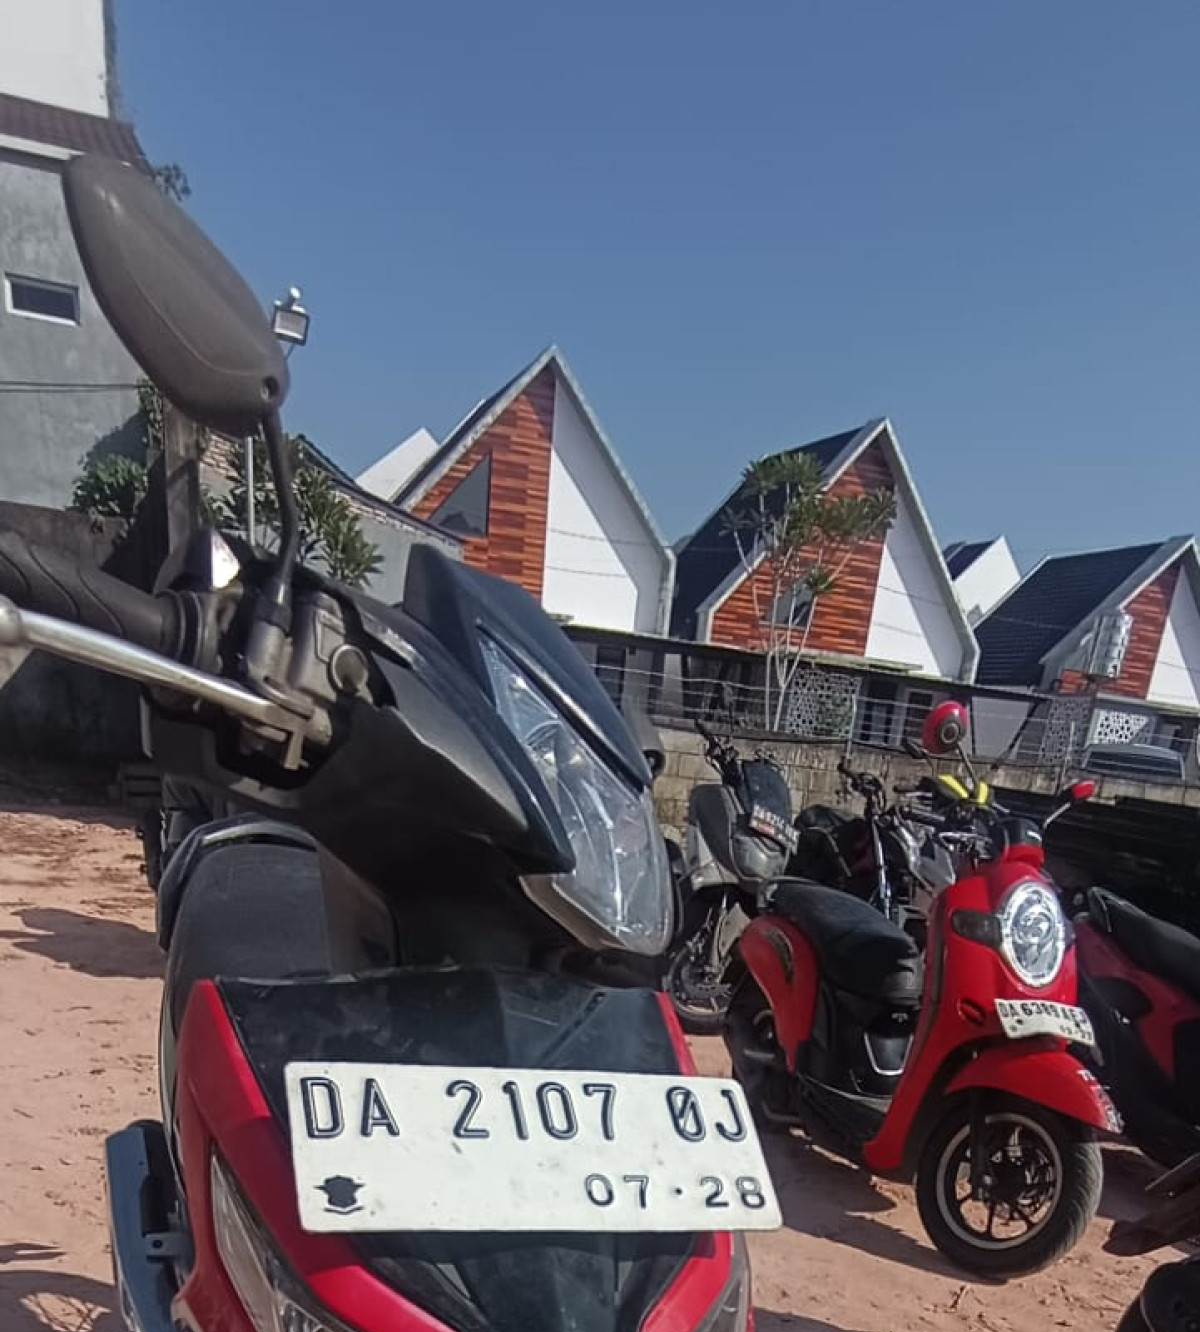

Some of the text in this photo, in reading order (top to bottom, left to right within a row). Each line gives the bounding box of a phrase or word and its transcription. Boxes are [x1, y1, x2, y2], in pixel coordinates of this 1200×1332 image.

[998, 1003, 1019, 1018] DA
[300, 1077, 400, 1138] DA
[446, 1080, 616, 1140] 2107
